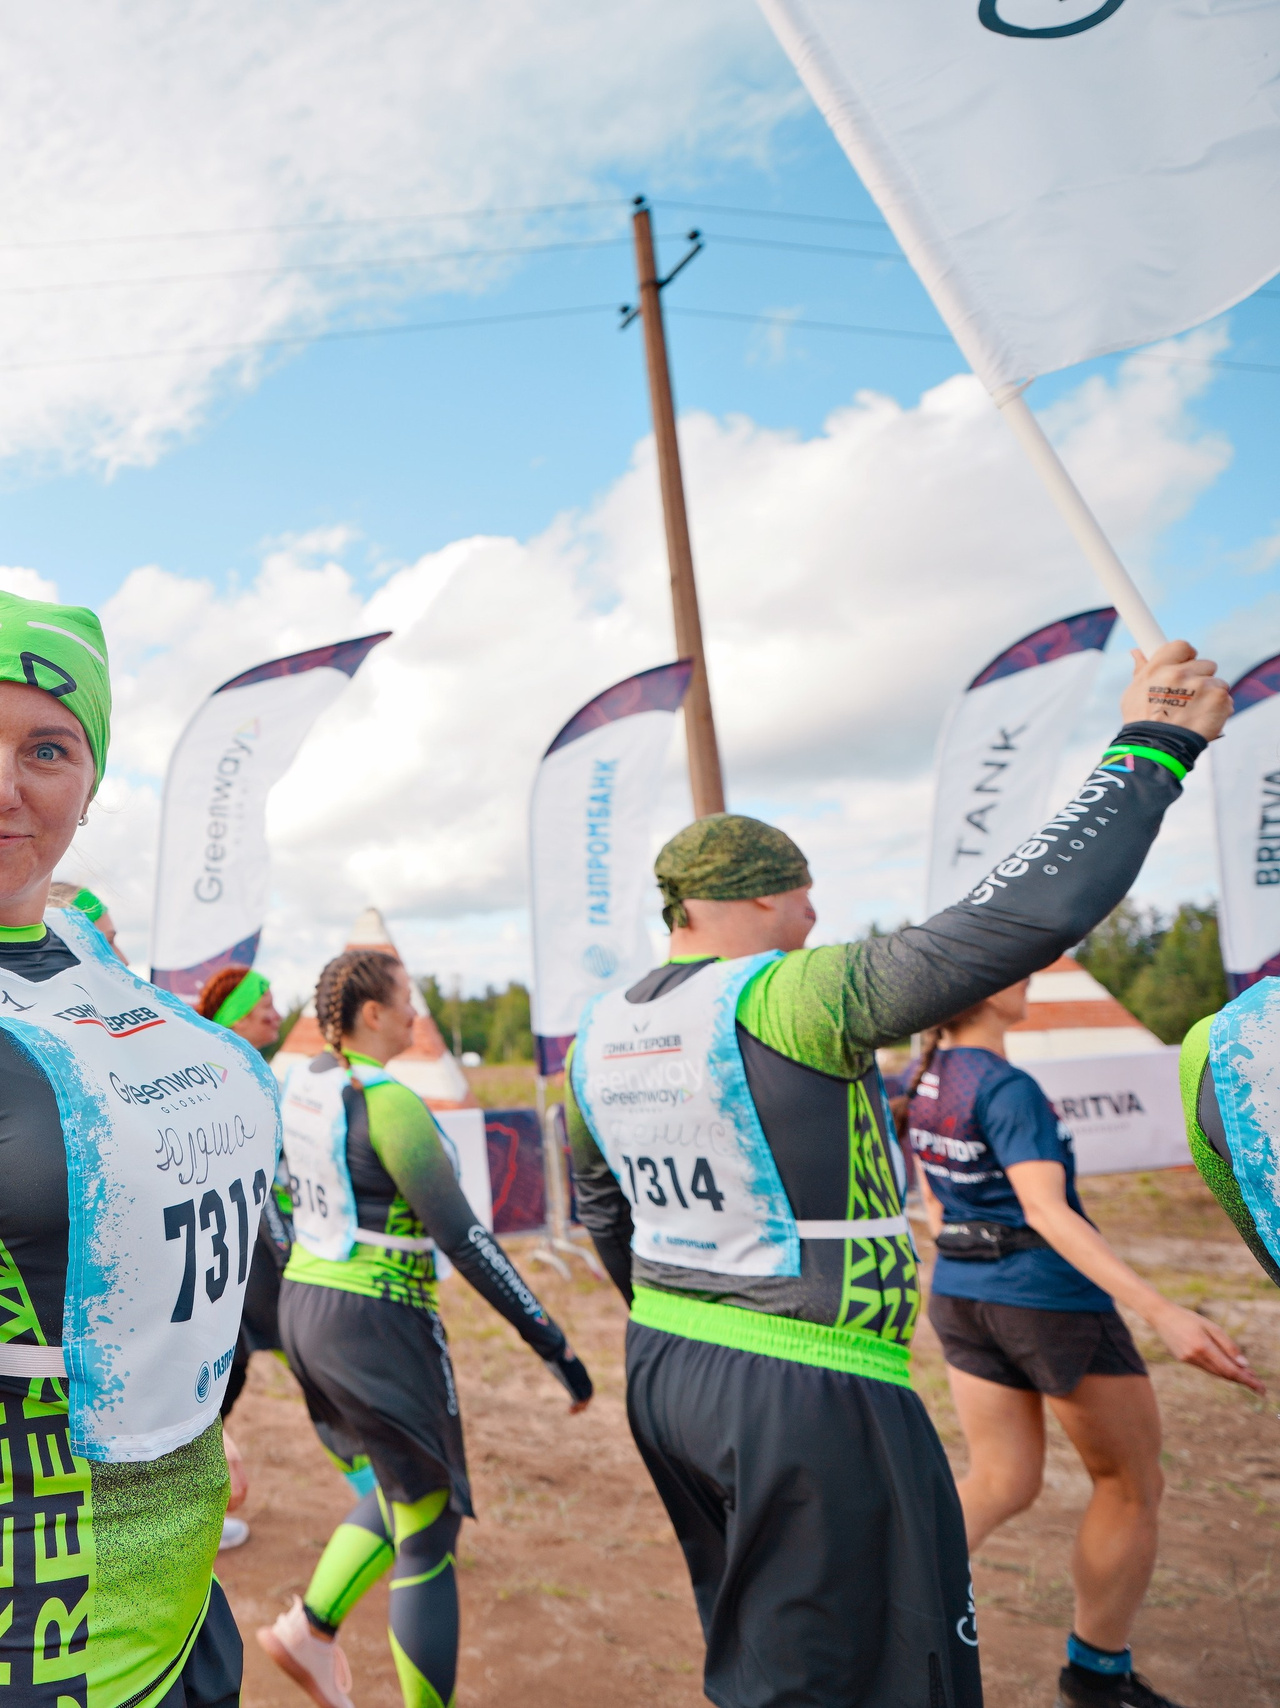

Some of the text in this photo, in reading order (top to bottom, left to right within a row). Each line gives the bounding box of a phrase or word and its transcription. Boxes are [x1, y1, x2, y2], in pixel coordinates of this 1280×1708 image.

[951, 722, 1030, 866] TANK
[193, 738, 253, 905] Greenway
[586, 758, 619, 926] ГАЗПРОМБАНК
[1042, 805, 1120, 876] GLOBAL
[103, 1007, 160, 1031] ЕРОЕВ
[108, 1061, 219, 1106] Greenway
[160, 1093, 211, 1114] GLOBAL
[601, 1086, 680, 1108] Greenway
[1060, 1092, 1146, 1119] RITVA
